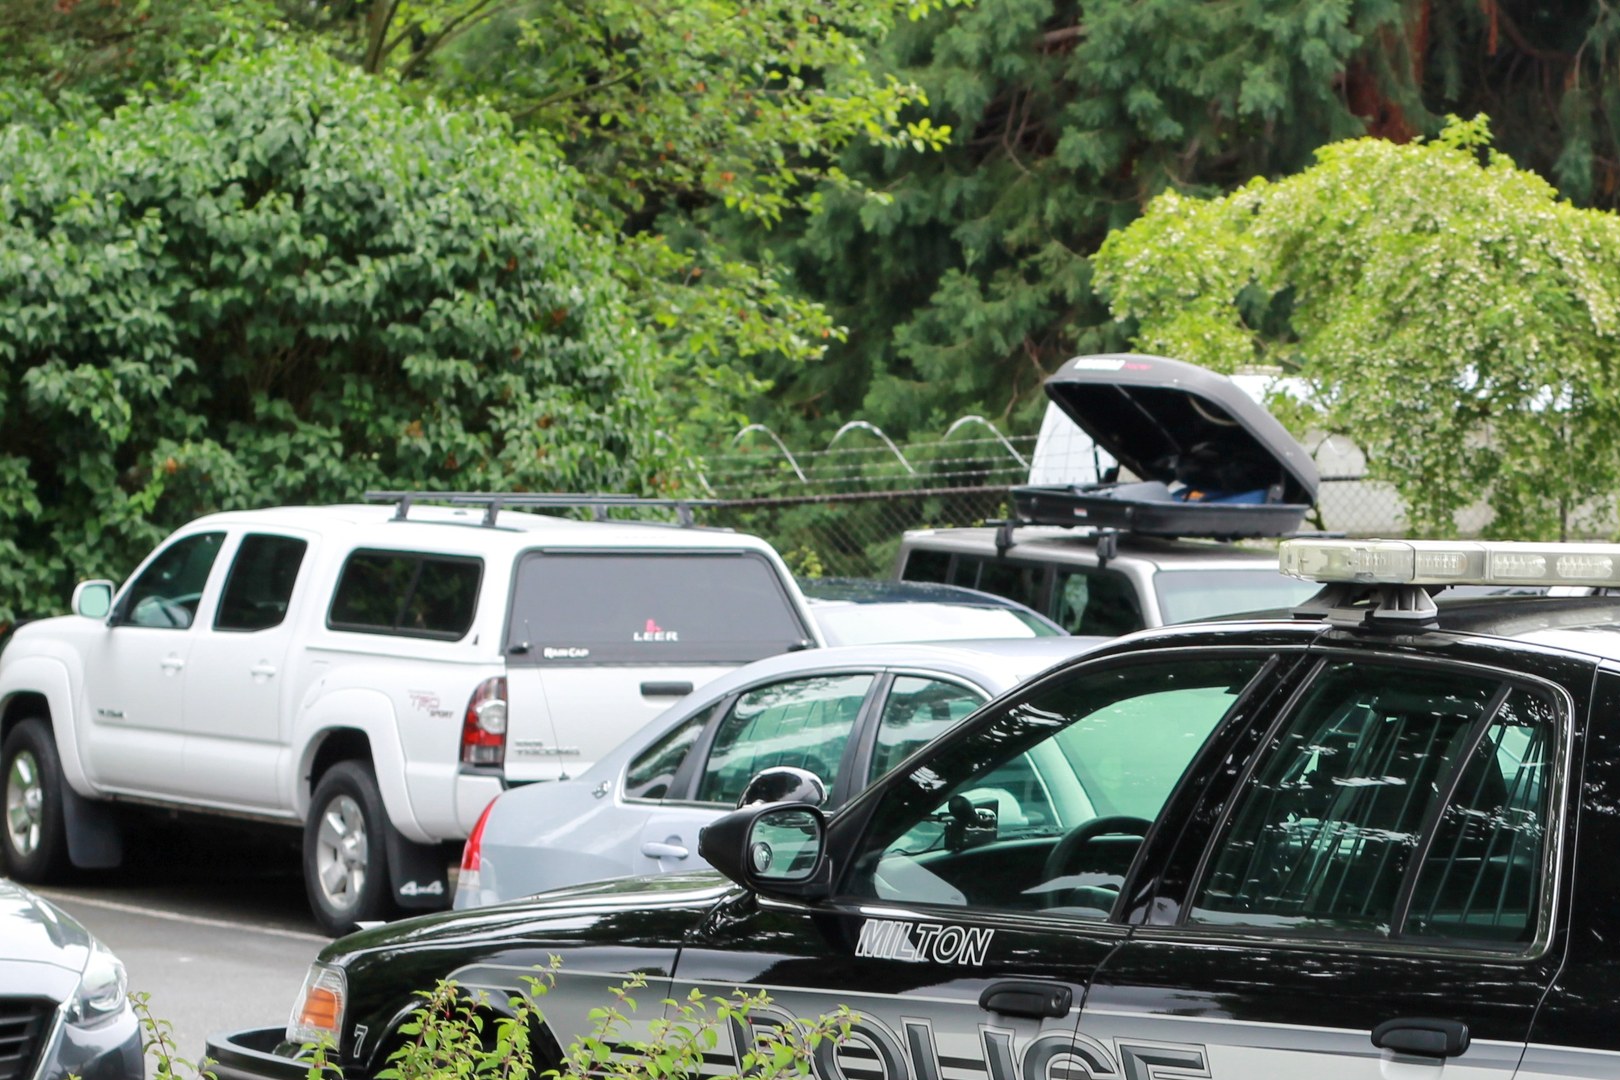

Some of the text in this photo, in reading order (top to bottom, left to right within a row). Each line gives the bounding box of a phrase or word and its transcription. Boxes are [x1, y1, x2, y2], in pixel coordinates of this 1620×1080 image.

[633, 631, 679, 642] LEER
[855, 918, 996, 966] MILTON
[353, 1023, 369, 1058] 7
